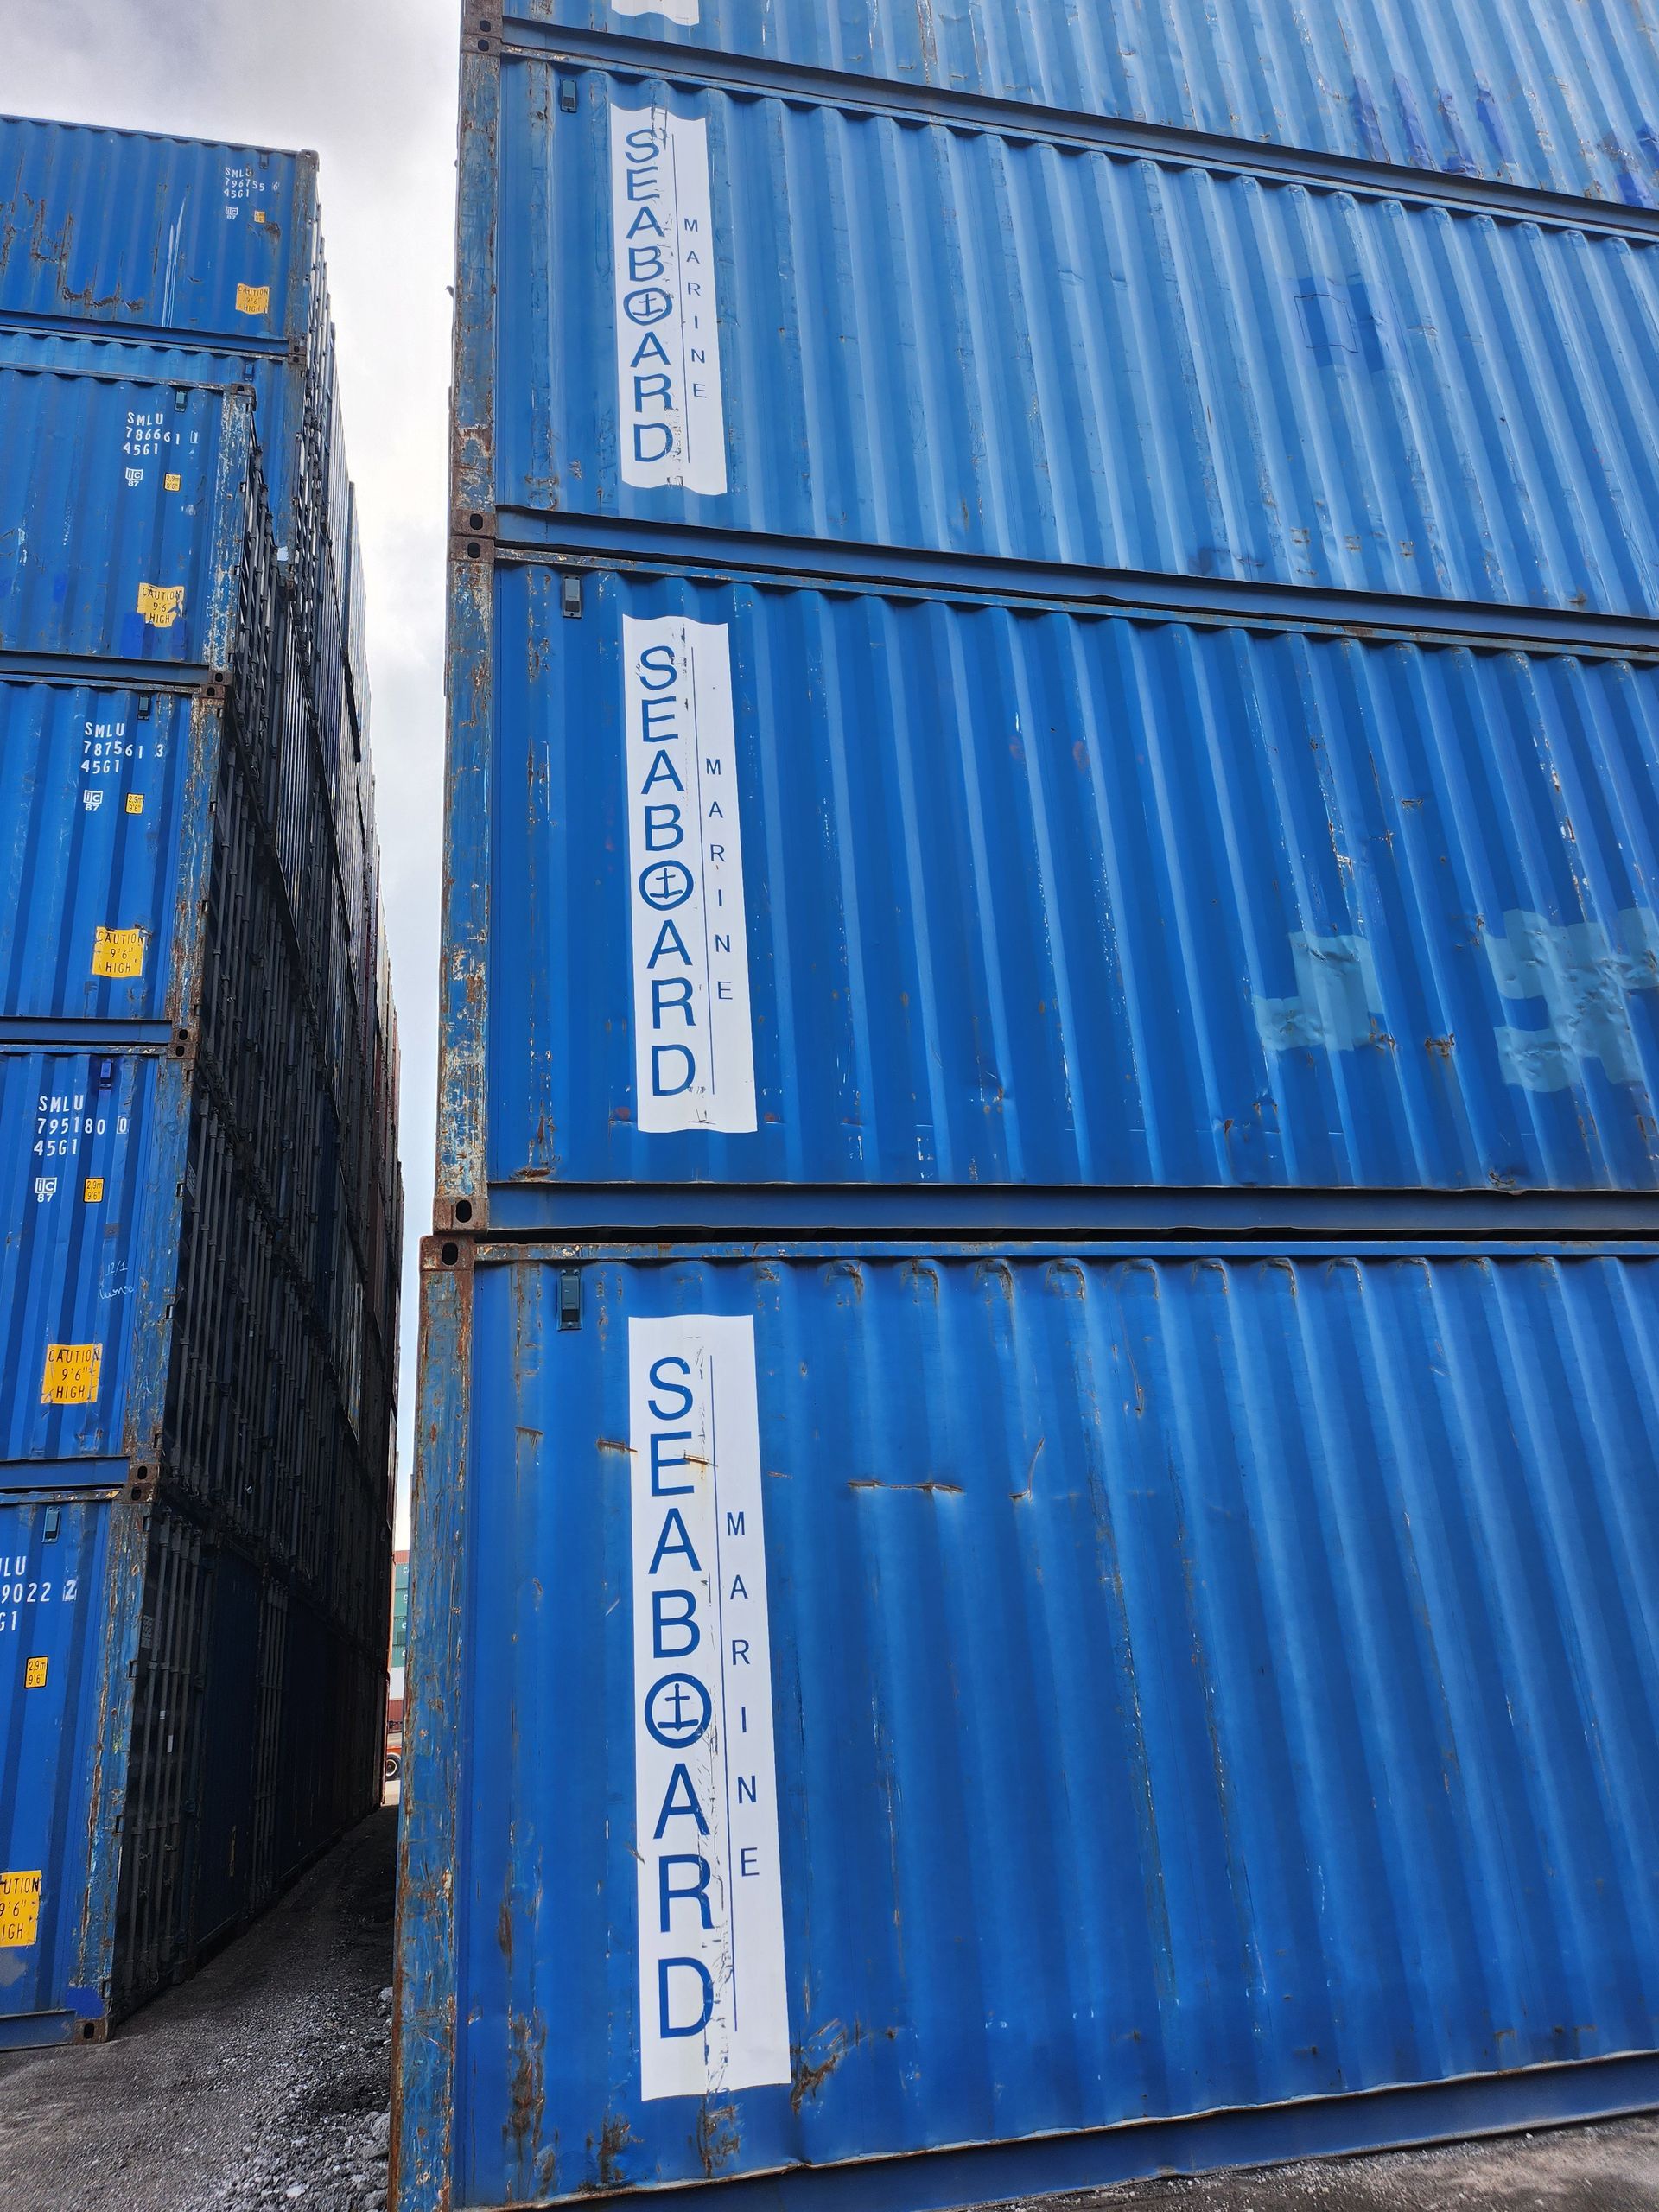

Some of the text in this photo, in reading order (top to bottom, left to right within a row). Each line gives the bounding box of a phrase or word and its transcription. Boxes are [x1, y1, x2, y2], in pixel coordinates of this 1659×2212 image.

[225, 167, 252, 178] SMLU
[225, 177, 265, 191] 796755
[224, 188, 250, 199] 45G1
[238, 285, 269, 296] CAUTION
[623, 128, 674, 462] SEABOARD
[683, 217, 708, 399] MARINE
[127, 411, 163, 426] SMLU
[125, 426, 180, 445] 786661
[123, 442, 158, 455] 45G1
[142, 587, 181, 600] CAUTION
[149, 613, 170, 623] HIGH
[85, 721, 125, 738] SMLU
[84, 740, 164, 759] 787561 3
[80, 759, 120, 774] 45G1
[639, 645, 696, 1097] SEABOARD
[706, 758, 733, 1000] MARINE
[98, 931, 143, 944] CAUTION
[105, 961, 131, 973] HIGH
[38, 1095, 84, 1112] SMLU
[37, 1116, 105, 1135] 795180
[33, 1138, 77, 1156] 45G1
[37, 1193, 54, 1202] 87
[48, 1349, 100, 1363] CAUTION
[55, 1385, 86, 1398] HIGH
[63, 1579, 79, 1601] 2
[645, 1357, 715, 2040] SEABOARD
[727, 1511, 760, 1877] MARINE
